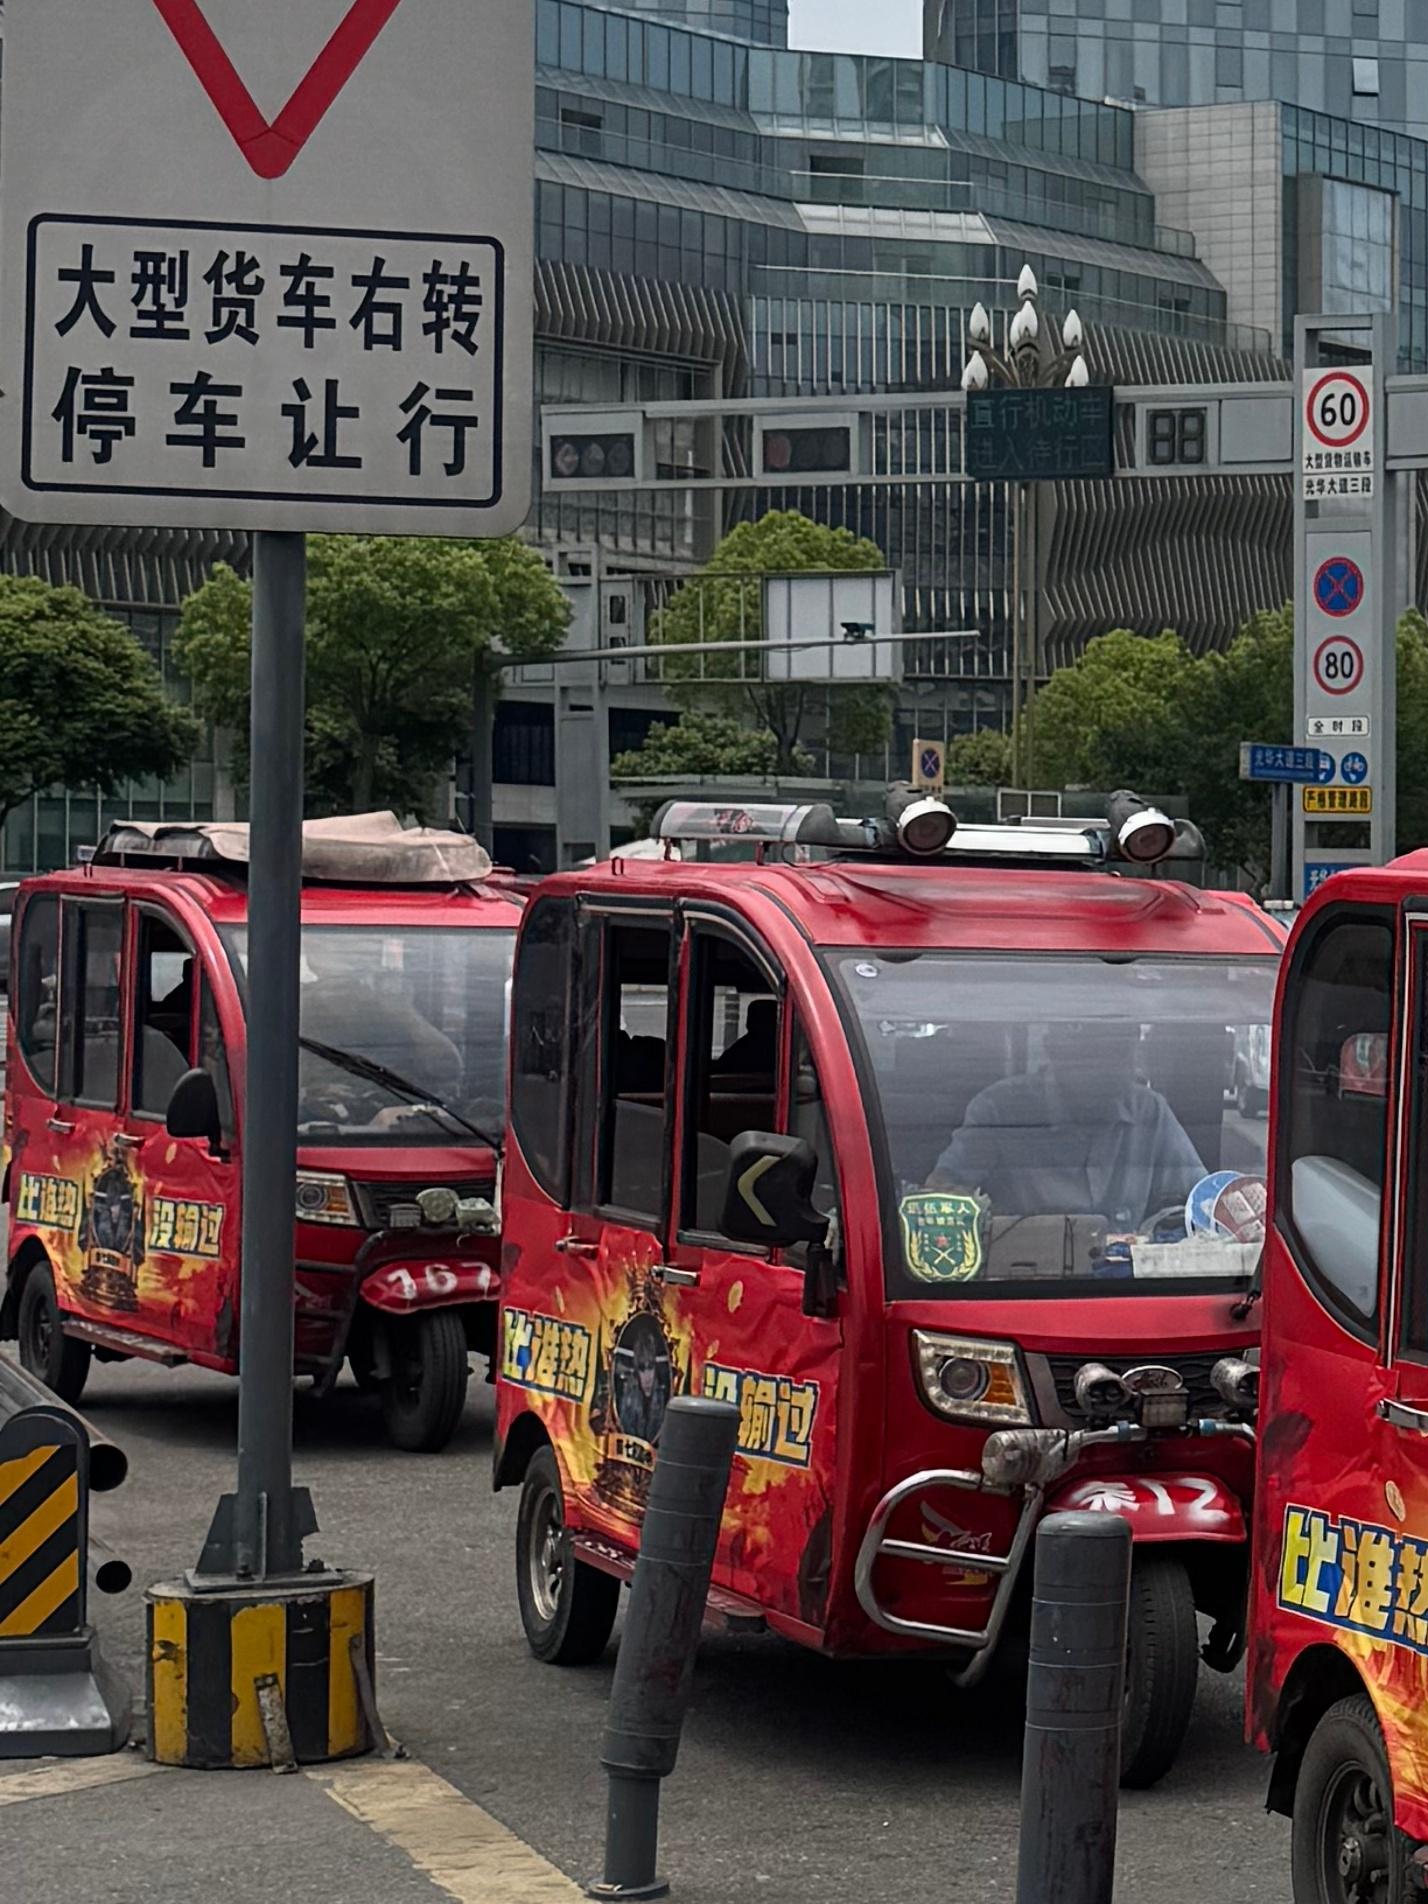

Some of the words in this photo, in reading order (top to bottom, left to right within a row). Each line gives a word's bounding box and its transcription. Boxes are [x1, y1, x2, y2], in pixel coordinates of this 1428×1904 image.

[52, 243, 484, 357] 大型货车右转
[51, 365, 480, 478] 停车让行
[1320, 392, 1356, 428] 60
[1305, 476, 1372, 496] 光华大道三段
[1323, 651, 1355, 681] 80
[1313, 719, 1364, 733] 全时段
[17, 1174, 77, 1230] 比谁热
[149, 1198, 222, 1257] 没输过
[503, 1310, 588, 1399] 比谁热
